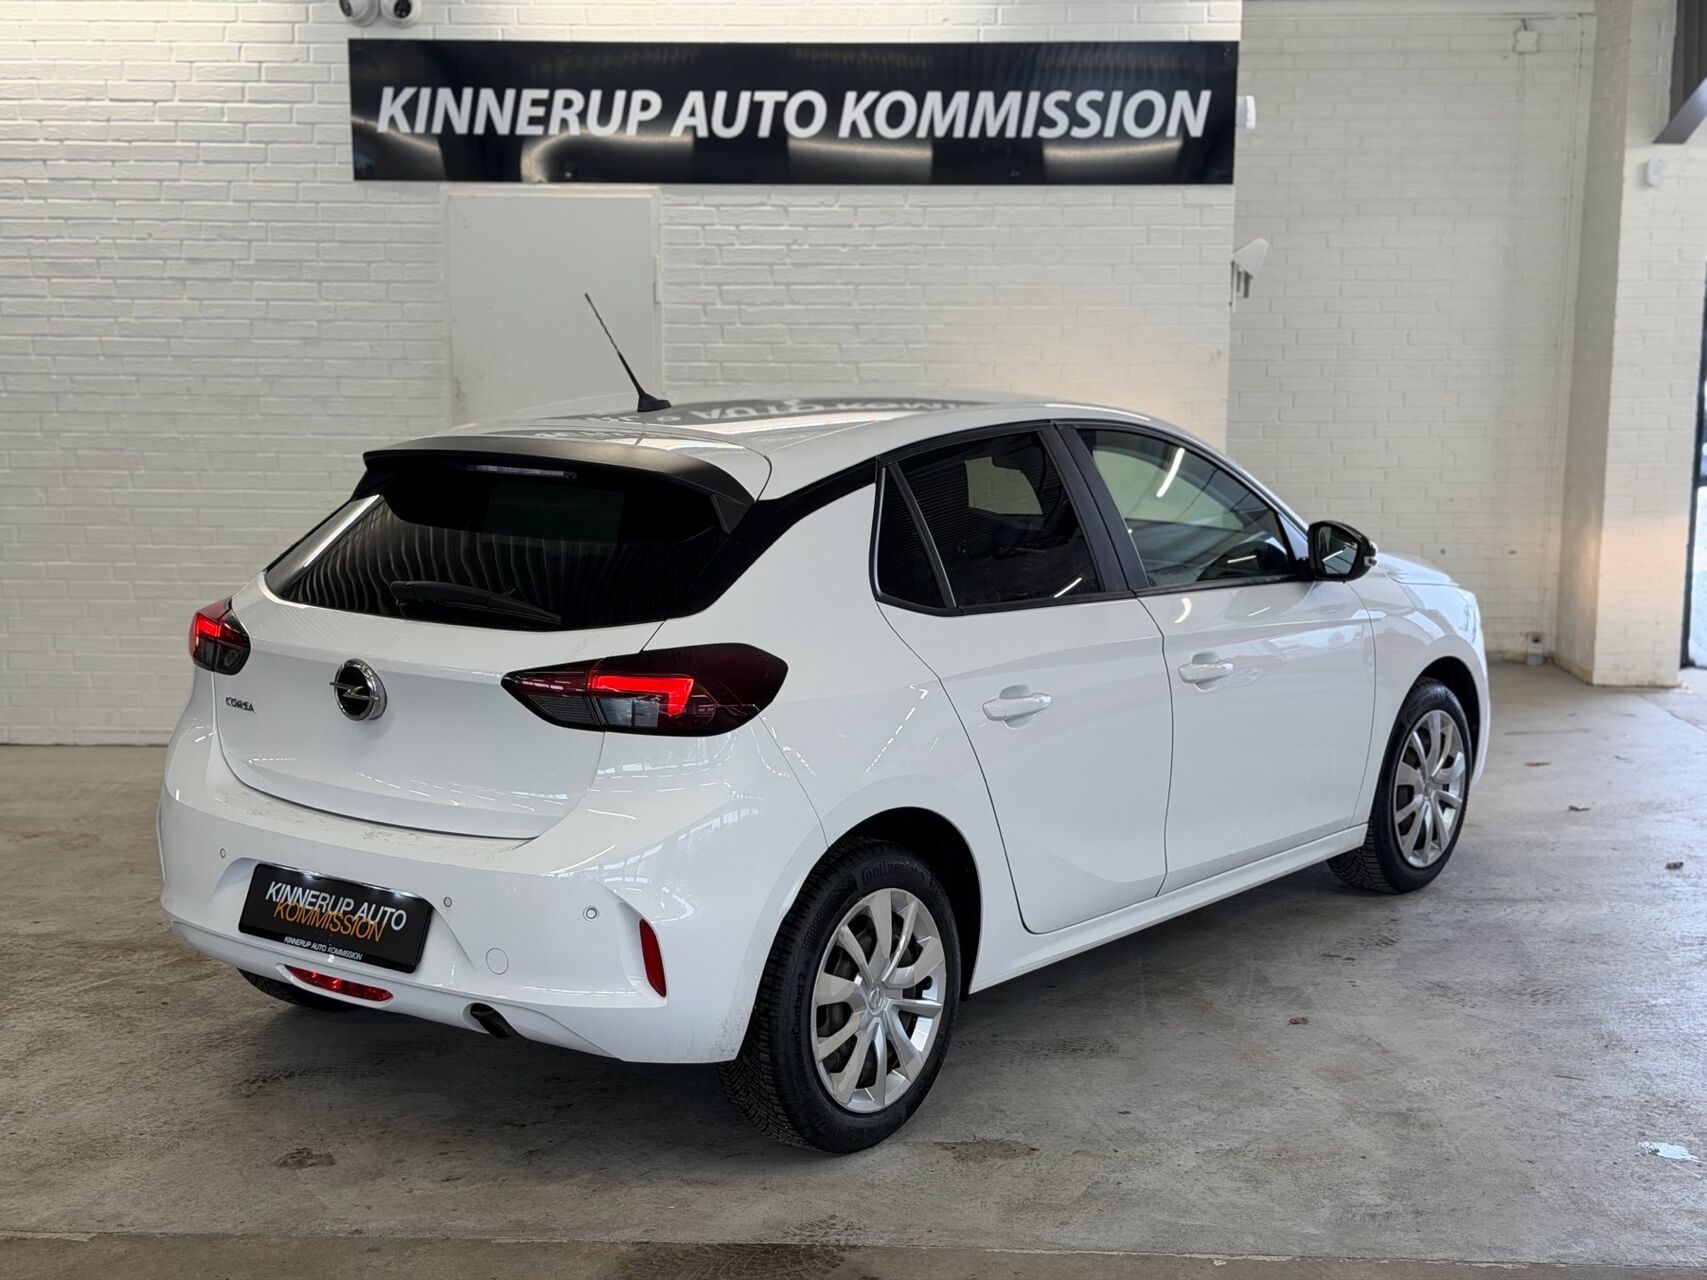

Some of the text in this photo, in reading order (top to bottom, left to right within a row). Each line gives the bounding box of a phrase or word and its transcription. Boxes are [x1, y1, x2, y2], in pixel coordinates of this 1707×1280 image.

[377, 86, 1211, 139] KINNERUP AUTO KOMMISSION
[225, 696, 255, 713] CORSA
[265, 881, 406, 930] KINNERUP AUTO
[274, 902, 385, 942] KOMMISSION
[284, 936, 363, 960] KINNERUP AUTO KOMMISSION
